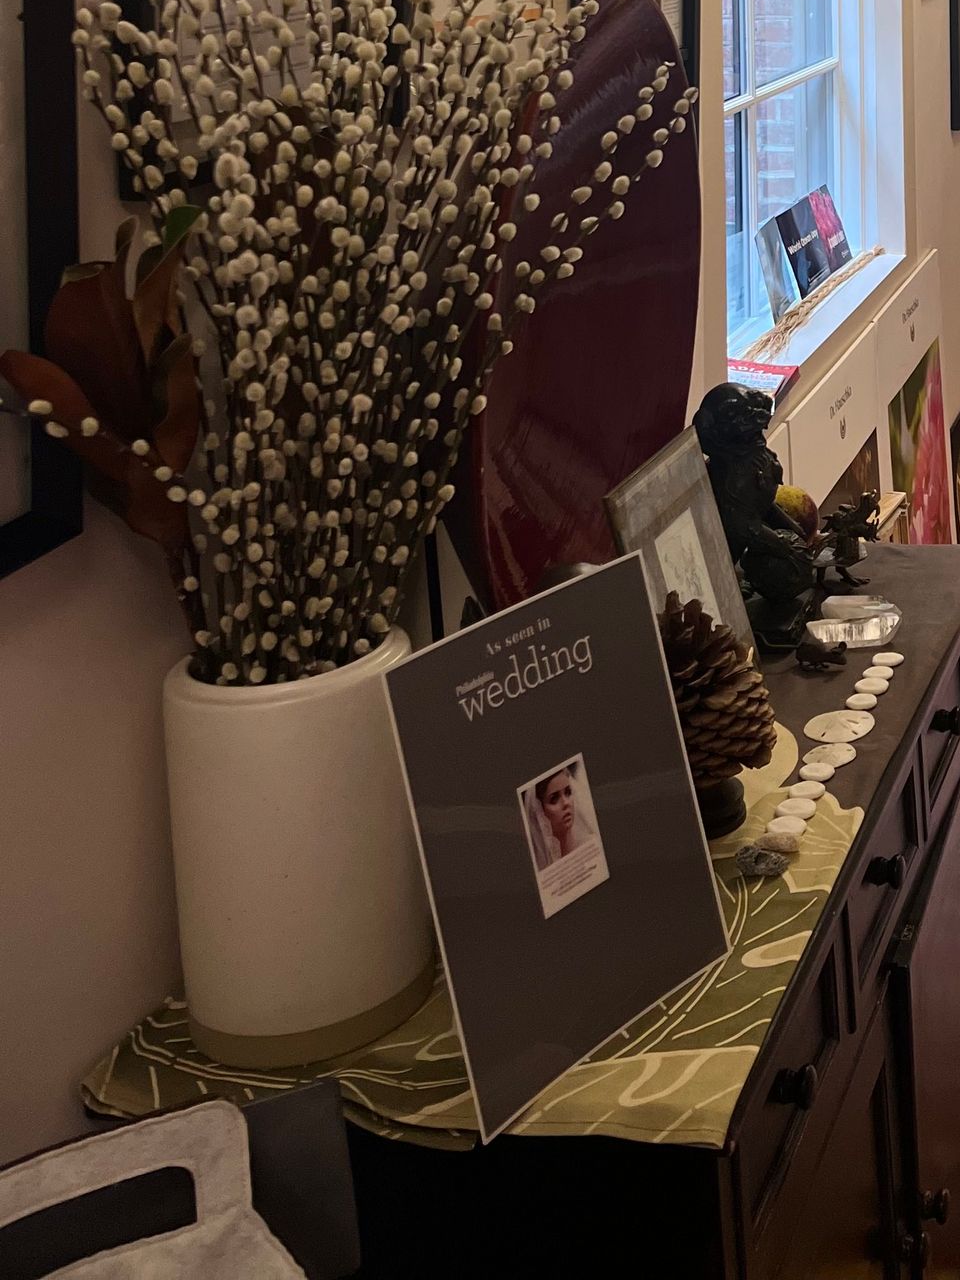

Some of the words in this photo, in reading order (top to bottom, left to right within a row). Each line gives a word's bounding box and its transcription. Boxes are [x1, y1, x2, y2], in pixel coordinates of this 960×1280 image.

[486, 643, 502, 656] As
[505, 626, 535, 648] seen
[536, 617, 551, 633] in
[458, 635, 593, 722] wedding
